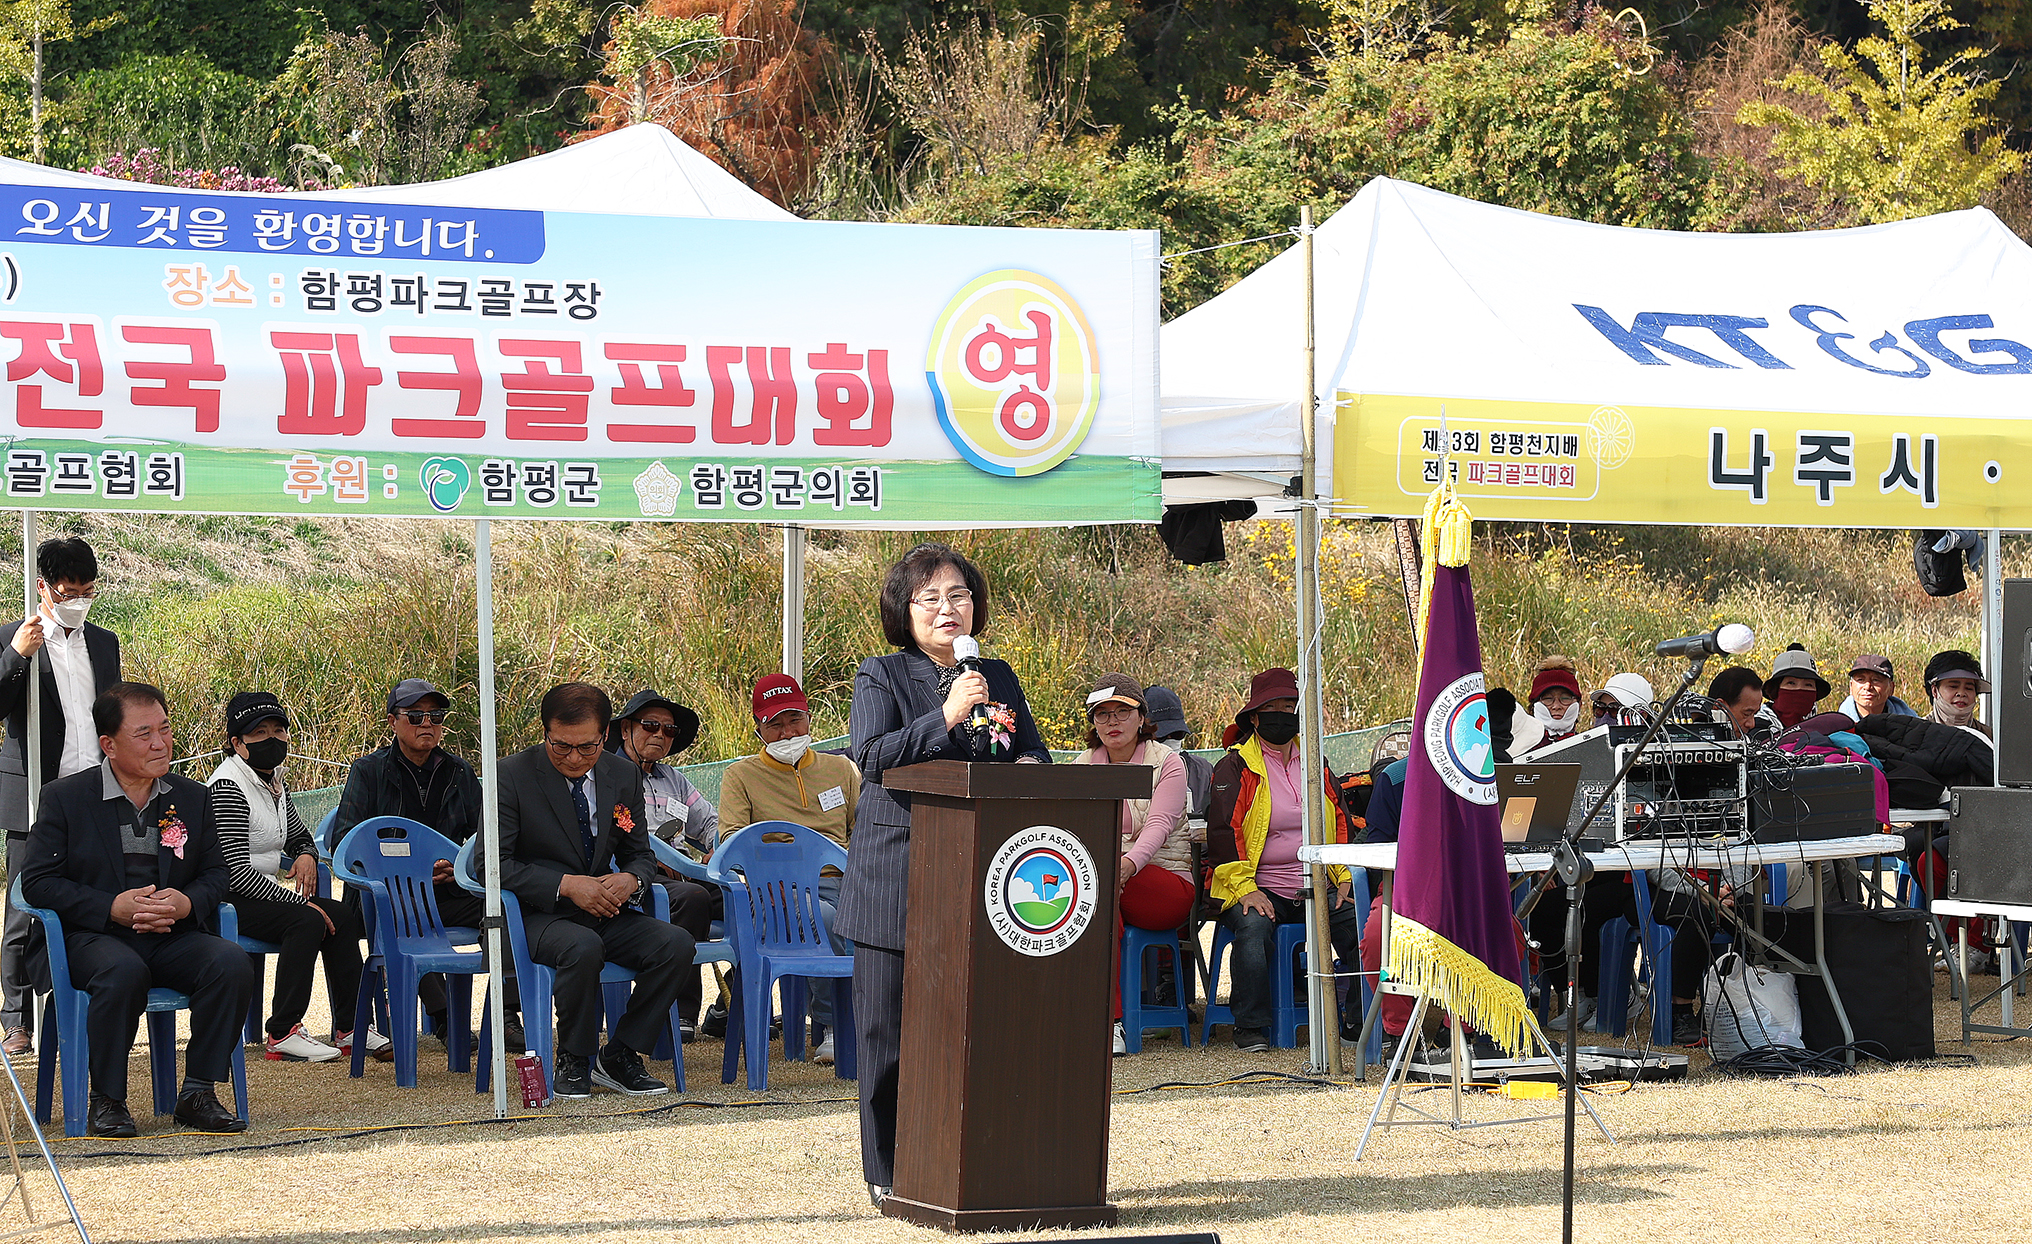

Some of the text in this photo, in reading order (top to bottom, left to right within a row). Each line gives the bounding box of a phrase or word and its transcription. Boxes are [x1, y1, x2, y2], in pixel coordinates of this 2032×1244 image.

[15, 200, 495, 259] 오신 것을 환영합니다.
[166, 267, 254, 306] 장소
[301, 271, 601, 320] 함평파크골프장
[0, 320, 894, 448] 전국 파크골프대회
[965, 310, 1052, 441] 영
[1422, 430, 1578, 457] 제3회 함평천지배
[287, 457, 367, 500] 후원
[482, 463, 599, 504] 함평군
[693, 467, 880, 507] 함평군의회
[1468, 463, 1574, 487] 파크골프대회
[762, 686, 794, 700] NITTAX
[1430, 696, 1453, 738] PARKGOLF
[1430, 740, 1463, 787] HAMPYEONG
[1513, 774, 1541, 783] ELF
[990, 832, 1092, 906] KOREA PARKGOLF ASSOCIATION
[991, 900, 1092, 953] (사)대한파크골프협회
